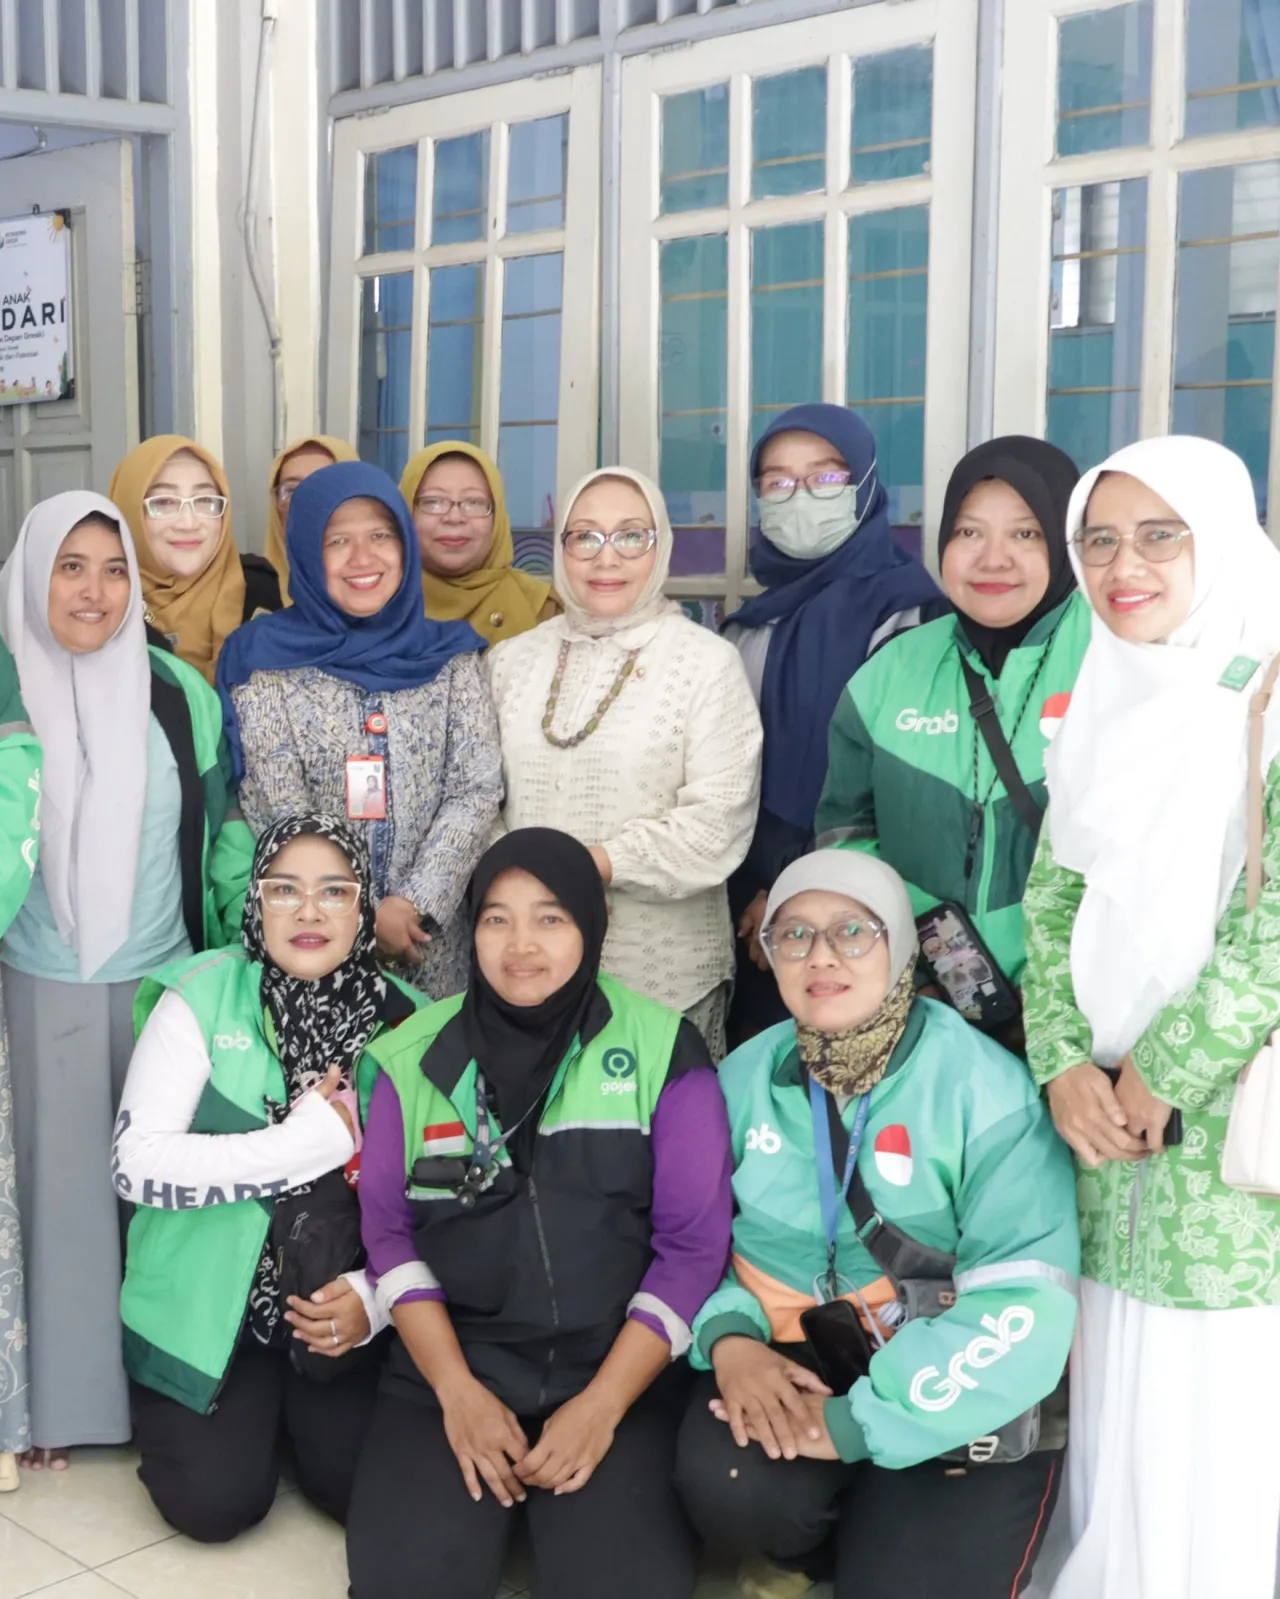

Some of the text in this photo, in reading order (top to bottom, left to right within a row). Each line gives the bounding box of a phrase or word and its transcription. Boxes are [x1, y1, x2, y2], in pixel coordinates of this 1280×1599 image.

[2, 291, 31, 306] ANAK
[895, 707, 959, 736] Grab
[213, 1029, 252, 1051] rab
[745, 1122, 782, 1154] ab
[909, 1305, 1035, 1412] Grab
